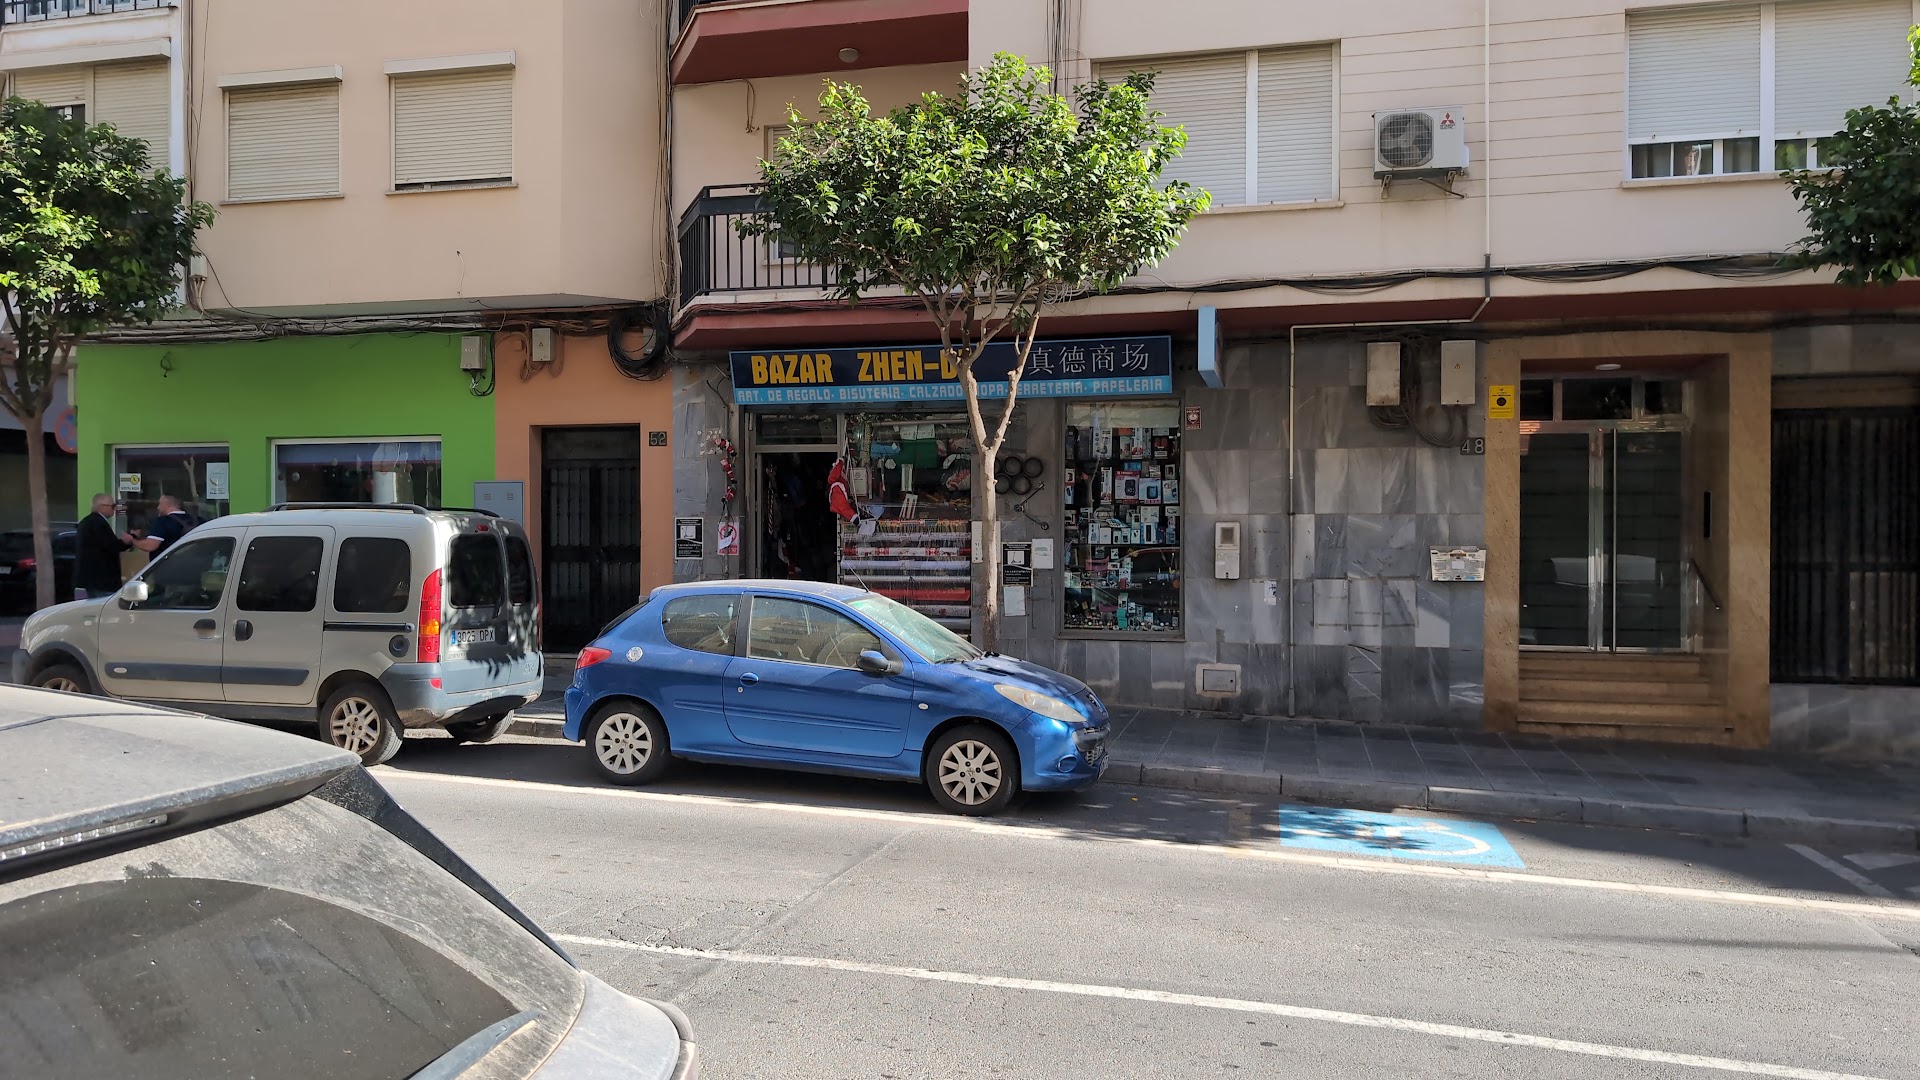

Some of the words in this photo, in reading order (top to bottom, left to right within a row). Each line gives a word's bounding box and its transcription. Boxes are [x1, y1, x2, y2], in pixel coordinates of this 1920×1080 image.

[751, 353, 834, 385] BAZAR
[857, 348, 974, 382] ZHEN-D
[1028, 343, 1149, 376] 真德商场
[738, 389, 763, 402] ART.
[768, 389, 783, 402] DE
[1093, 378, 1162, 393] PAPELERIA
[650, 432, 667, 446] 52
[1461, 439, 1484, 454] 48
[457, 630, 476, 643] 3025
[479, 629, 495, 642] DPX
